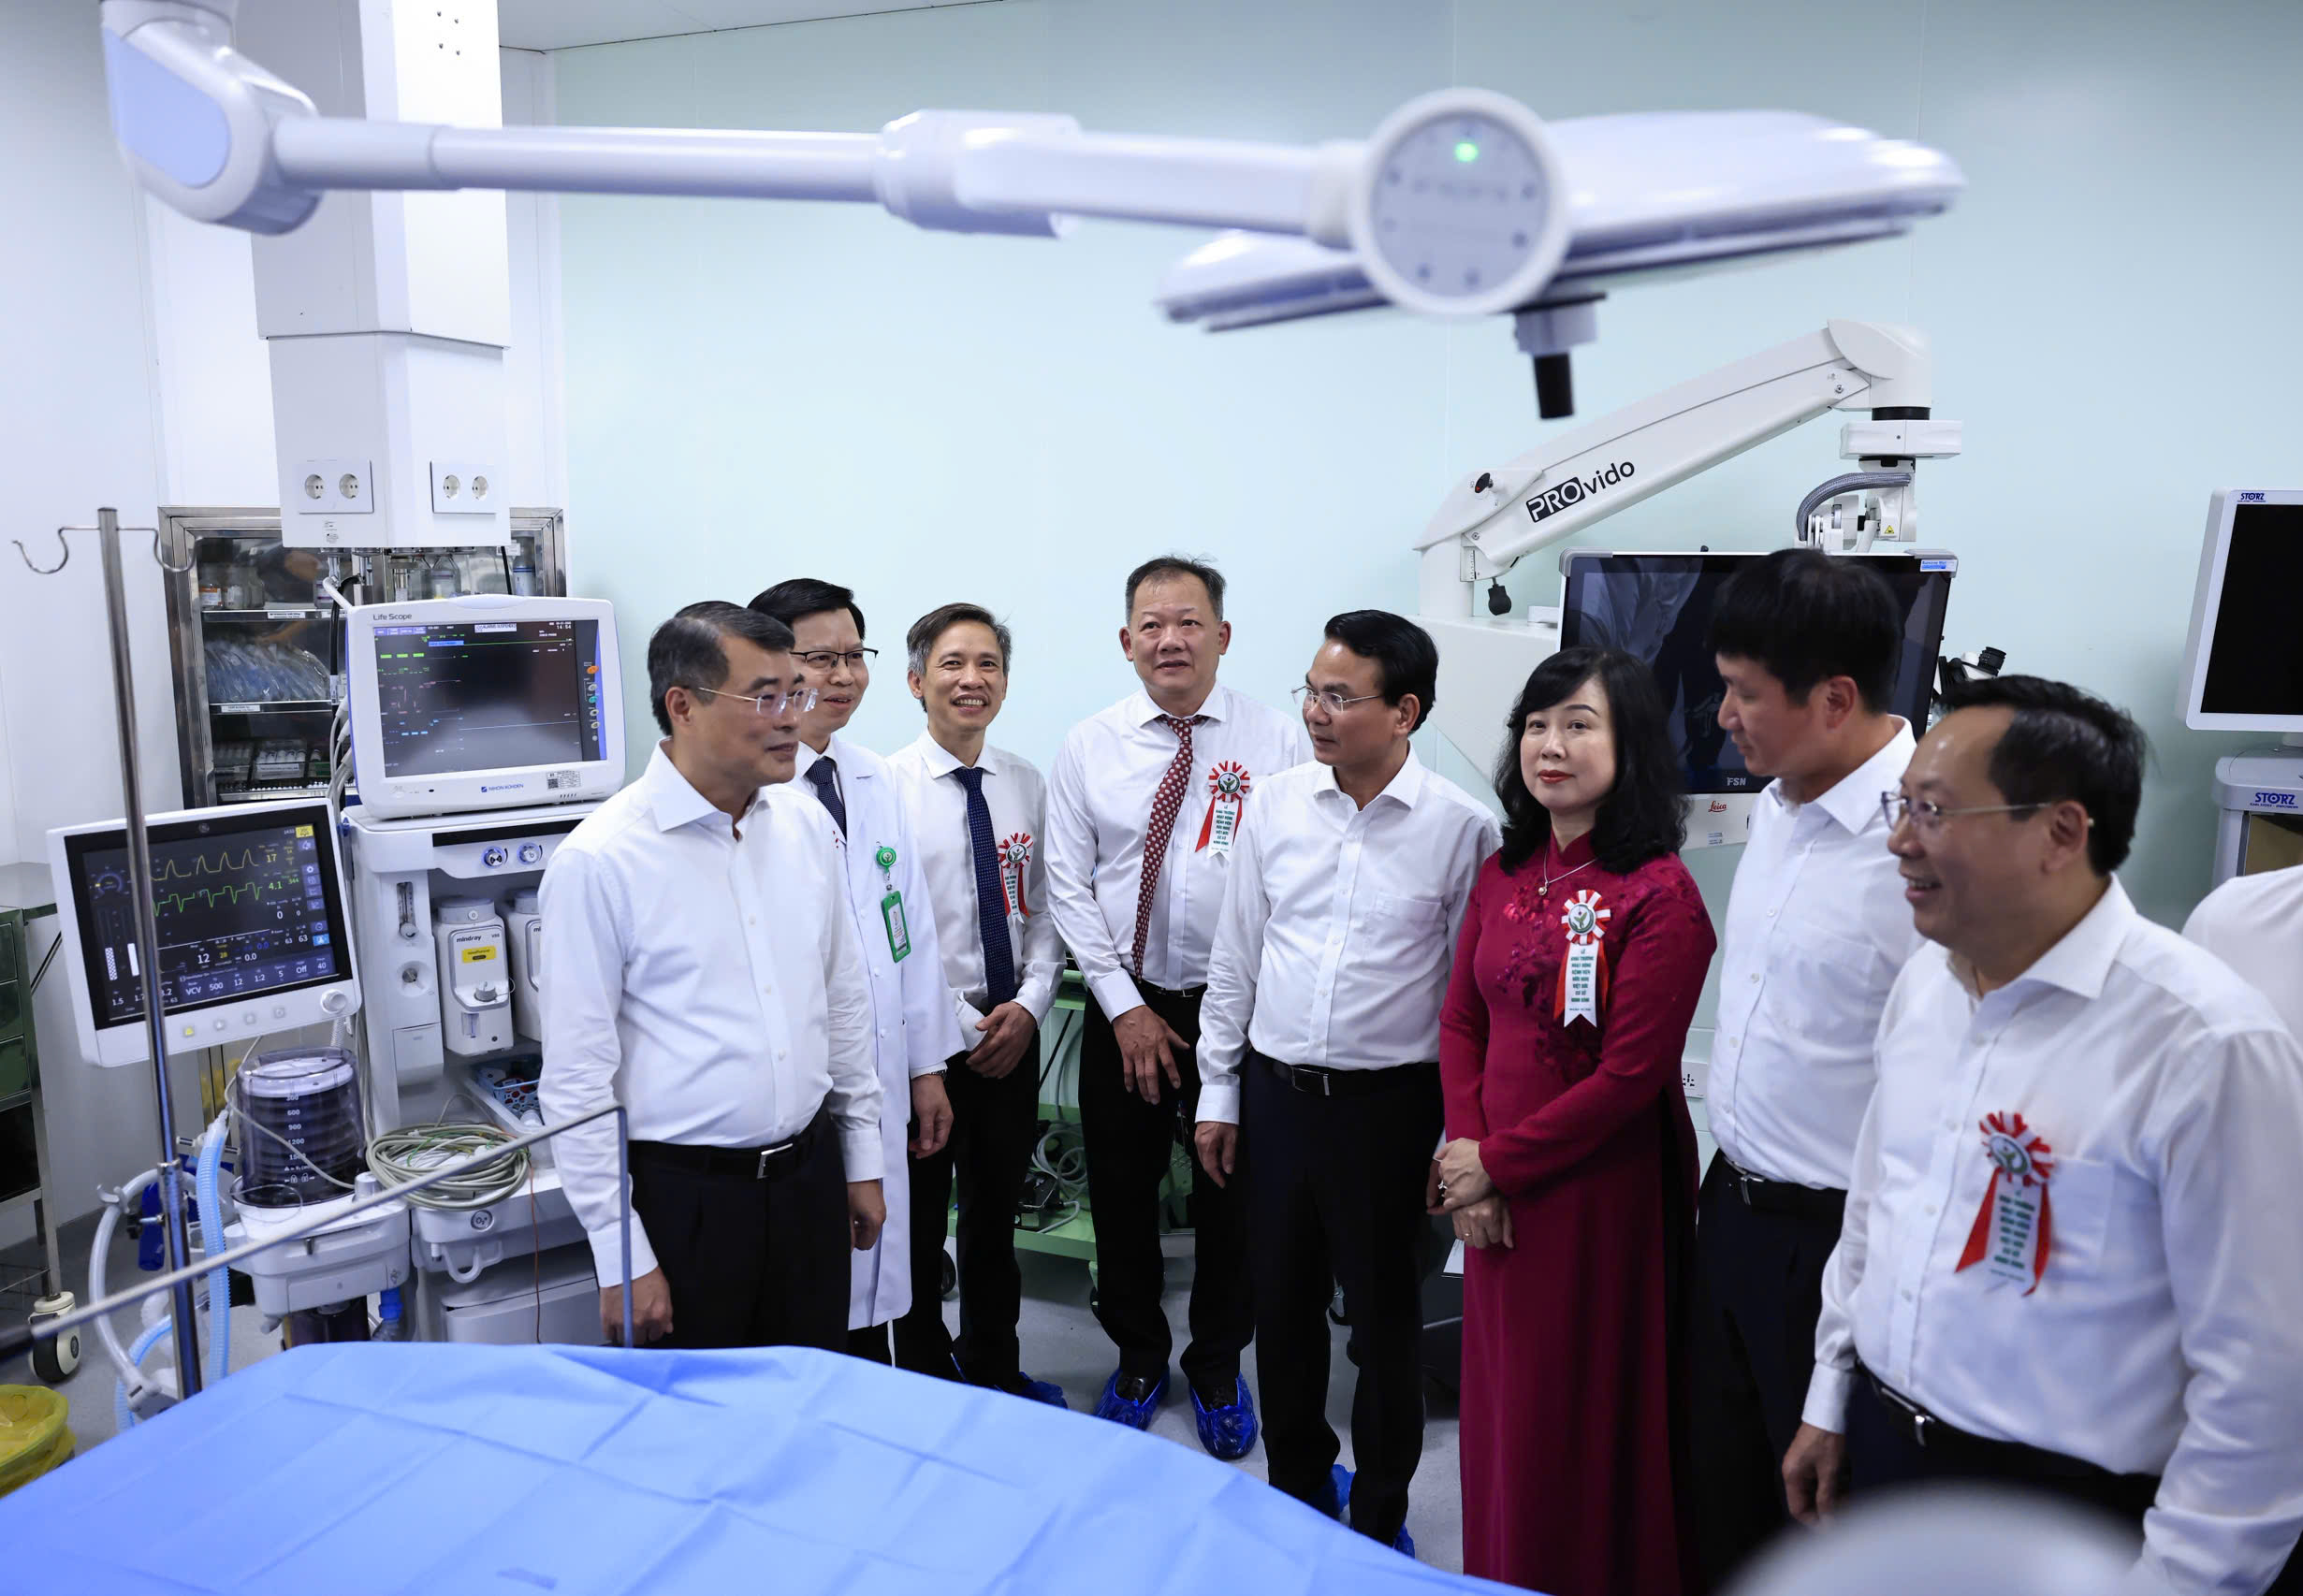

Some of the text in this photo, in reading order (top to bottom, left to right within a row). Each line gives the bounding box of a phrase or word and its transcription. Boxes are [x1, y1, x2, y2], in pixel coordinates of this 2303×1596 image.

[1526, 462, 1635, 522] PROvido
[2240, 492, 2265, 501] STORZ
[388, 613, 413, 621] Scope
[2255, 792, 2296, 805] STORZ
[1708, 800, 1727, 813] Leica
[266, 853, 278, 863] 17
[269, 881, 283, 890] 4.1
[298, 935, 309, 943] 63
[197, 953, 211, 965] 12
[244, 952, 257, 963] 0.0
[296, 965, 308, 974] Off
[317, 962, 327, 970] 40
[279, 970, 284, 979] 5
[209, 982, 224, 991] 500
[234, 979, 243, 987] 12
[185, 986, 202, 996] VCV
